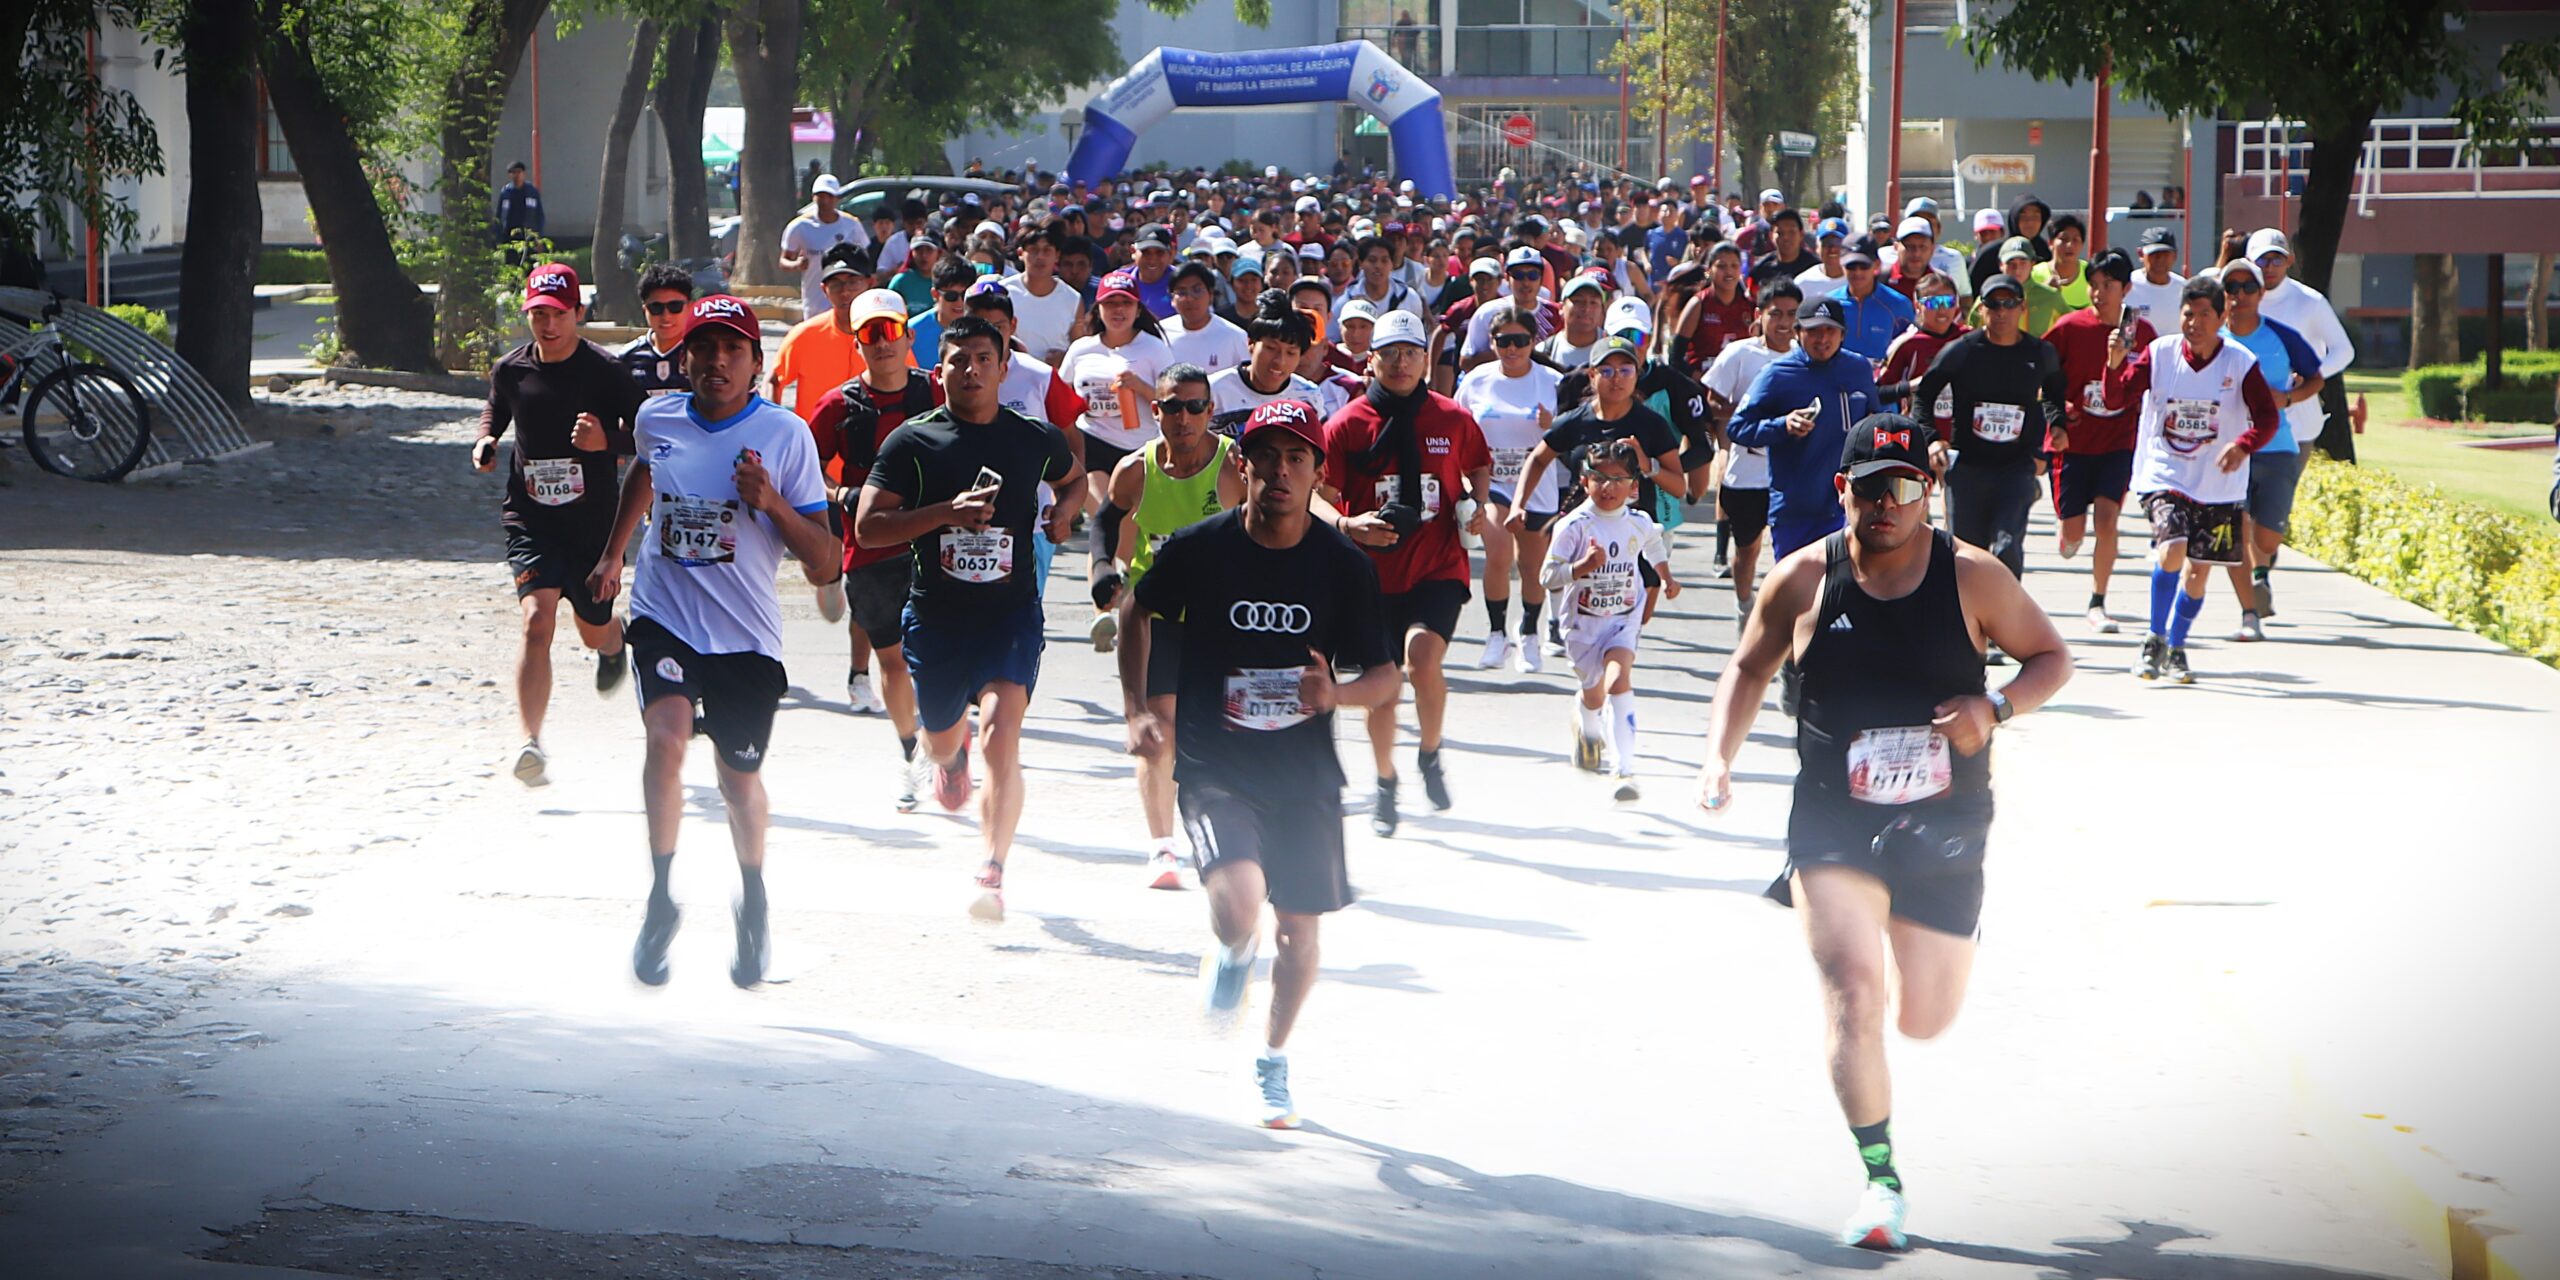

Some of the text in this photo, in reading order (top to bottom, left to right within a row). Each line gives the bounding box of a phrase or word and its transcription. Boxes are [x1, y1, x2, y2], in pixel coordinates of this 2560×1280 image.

[1235, 62, 1289, 75] PROVINCIAL
[1291, 60, 1303, 72] DE
[1305, 57, 1351, 72] AREQUIPA
[1245, 79, 1258, 90] LA
[530, 273, 568, 289] UNSA
[1103, 275, 1134, 288] UNSA
[694, 298, 745, 317] UNSA
[1255, 402, 1307, 424] UNSA
[1983, 423, 2011, 434] 0191
[2178, 419, 2208, 430] 0585
[1425, 437, 1451, 446] UNSA
[537, 483, 570, 496] 0168
[673, 530, 718, 548] 0147
[957, 557, 998, 571] 0637
[1591, 595, 1623, 608] 0830
[1250, 702, 1298, 717] 0173
